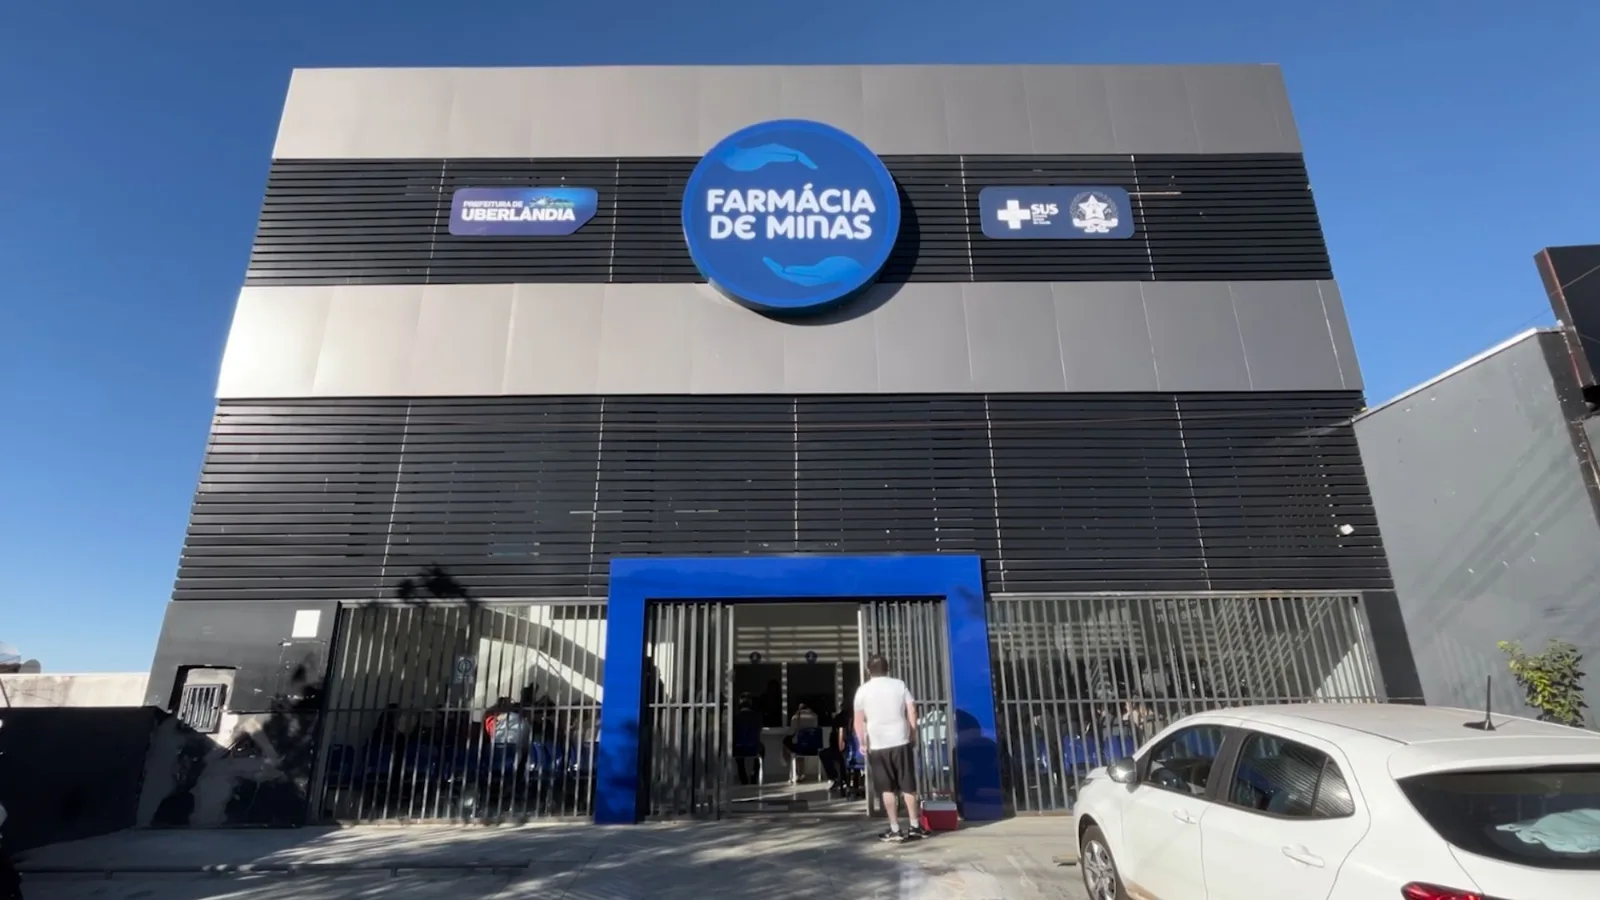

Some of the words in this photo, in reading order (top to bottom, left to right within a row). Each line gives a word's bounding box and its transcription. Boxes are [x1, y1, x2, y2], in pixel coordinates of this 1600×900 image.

[463, 200, 512, 208] PREFEITURA
[513, 200, 524, 208] DE
[706, 182, 876, 213] FARMÁCIA
[1030, 203, 1059, 216] SUS
[710, 215, 756, 240] DE
[766, 215, 872, 240] MINAS
